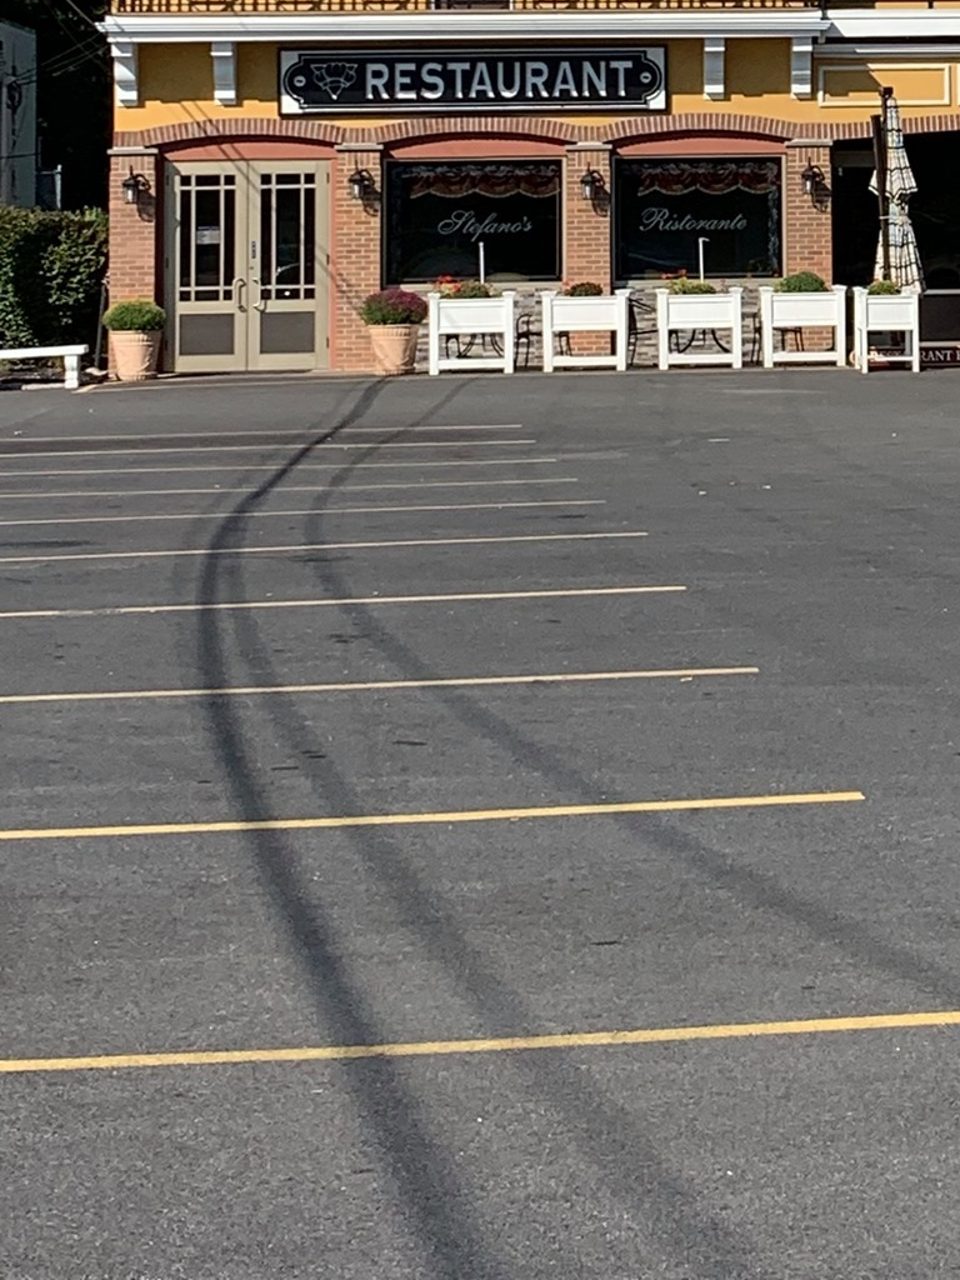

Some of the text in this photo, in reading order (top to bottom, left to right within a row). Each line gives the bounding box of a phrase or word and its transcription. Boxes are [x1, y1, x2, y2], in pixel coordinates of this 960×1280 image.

[364, 60, 634, 101] RESTAURANT
[437, 209, 533, 242] Stefano's
[638, 206, 748, 232] Ristorante
